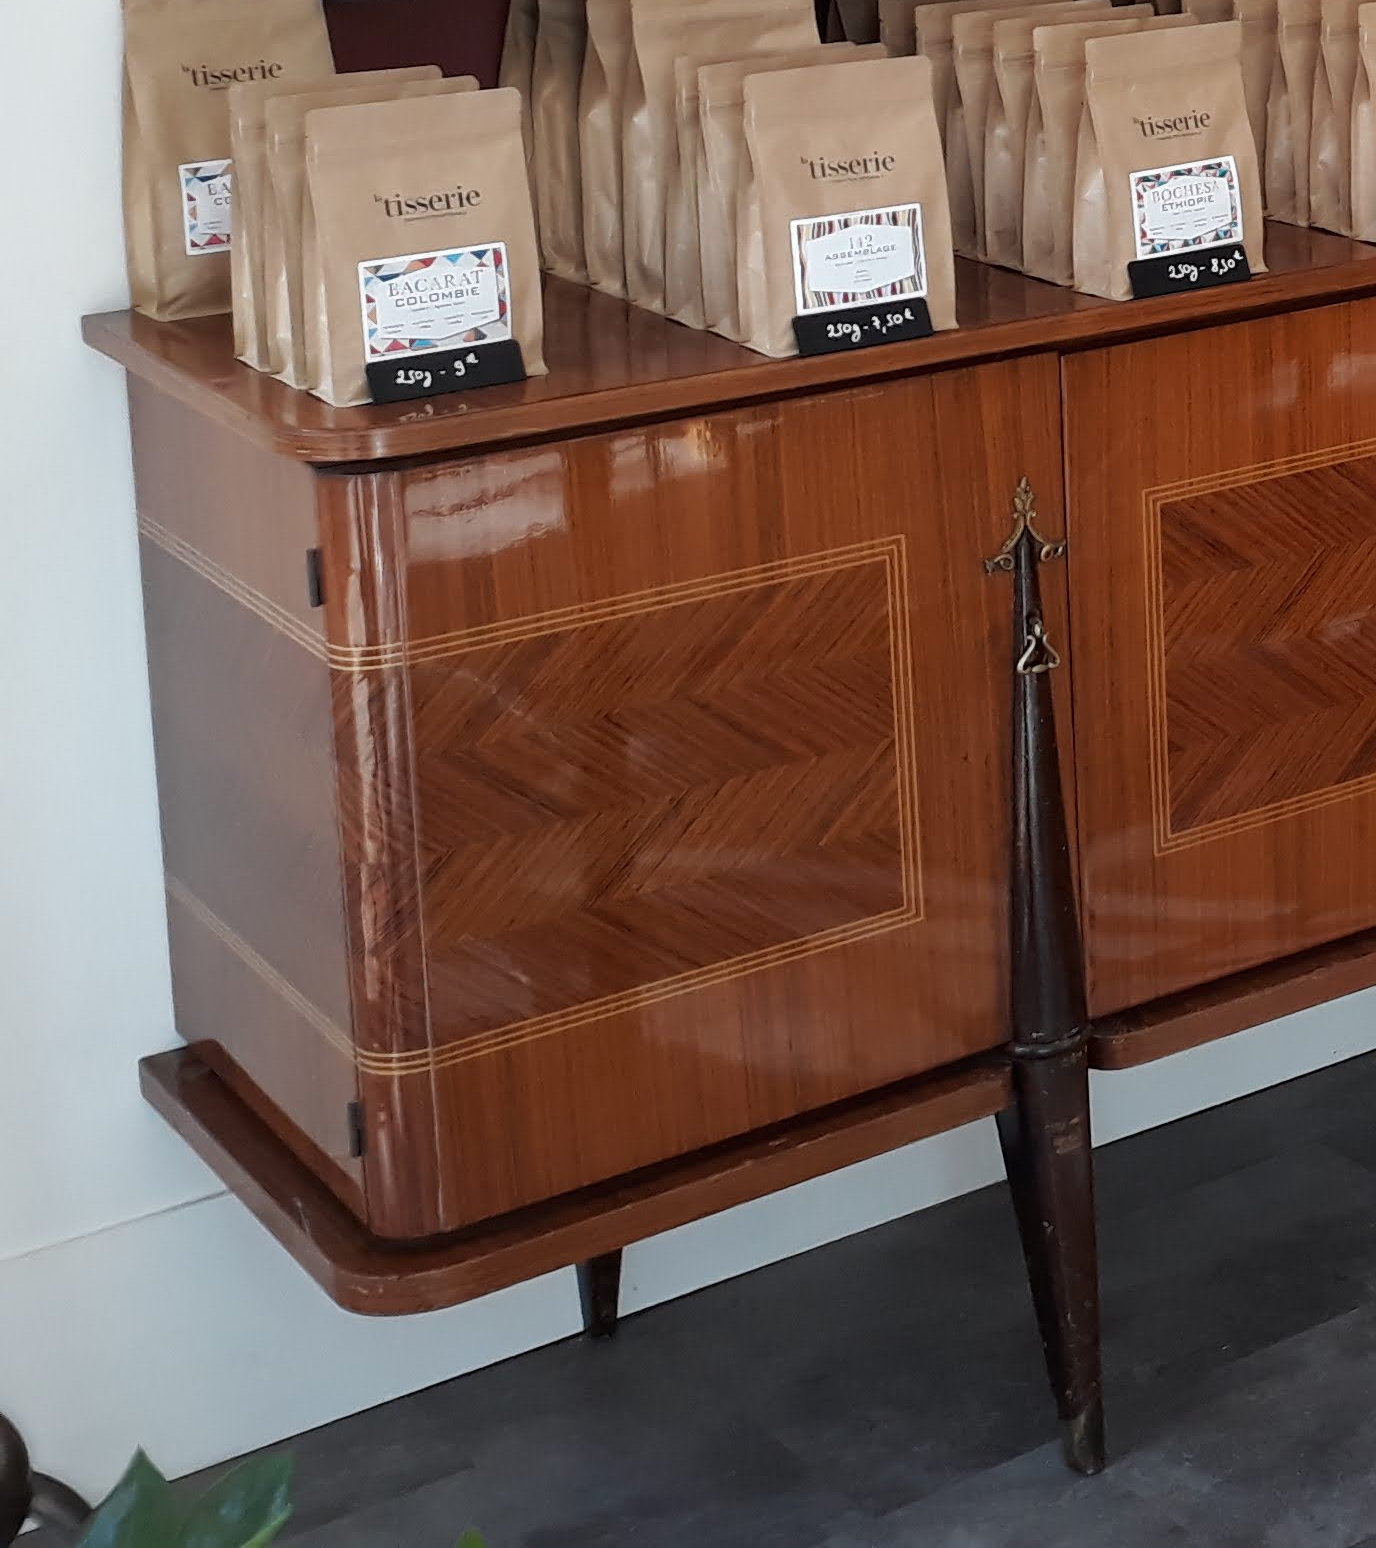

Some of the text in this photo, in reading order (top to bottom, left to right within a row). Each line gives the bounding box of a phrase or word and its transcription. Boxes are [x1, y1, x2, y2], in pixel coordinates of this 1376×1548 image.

[190, 60, 283, 87] tisserie
[1140, 110, 1211, 138] tisserie
[809, 151, 895, 179] tisserie
[383, 185, 481, 219] tisserie
[388, 269, 486, 298] BACARAT
[395, 286, 480, 309] COLOMBIE
